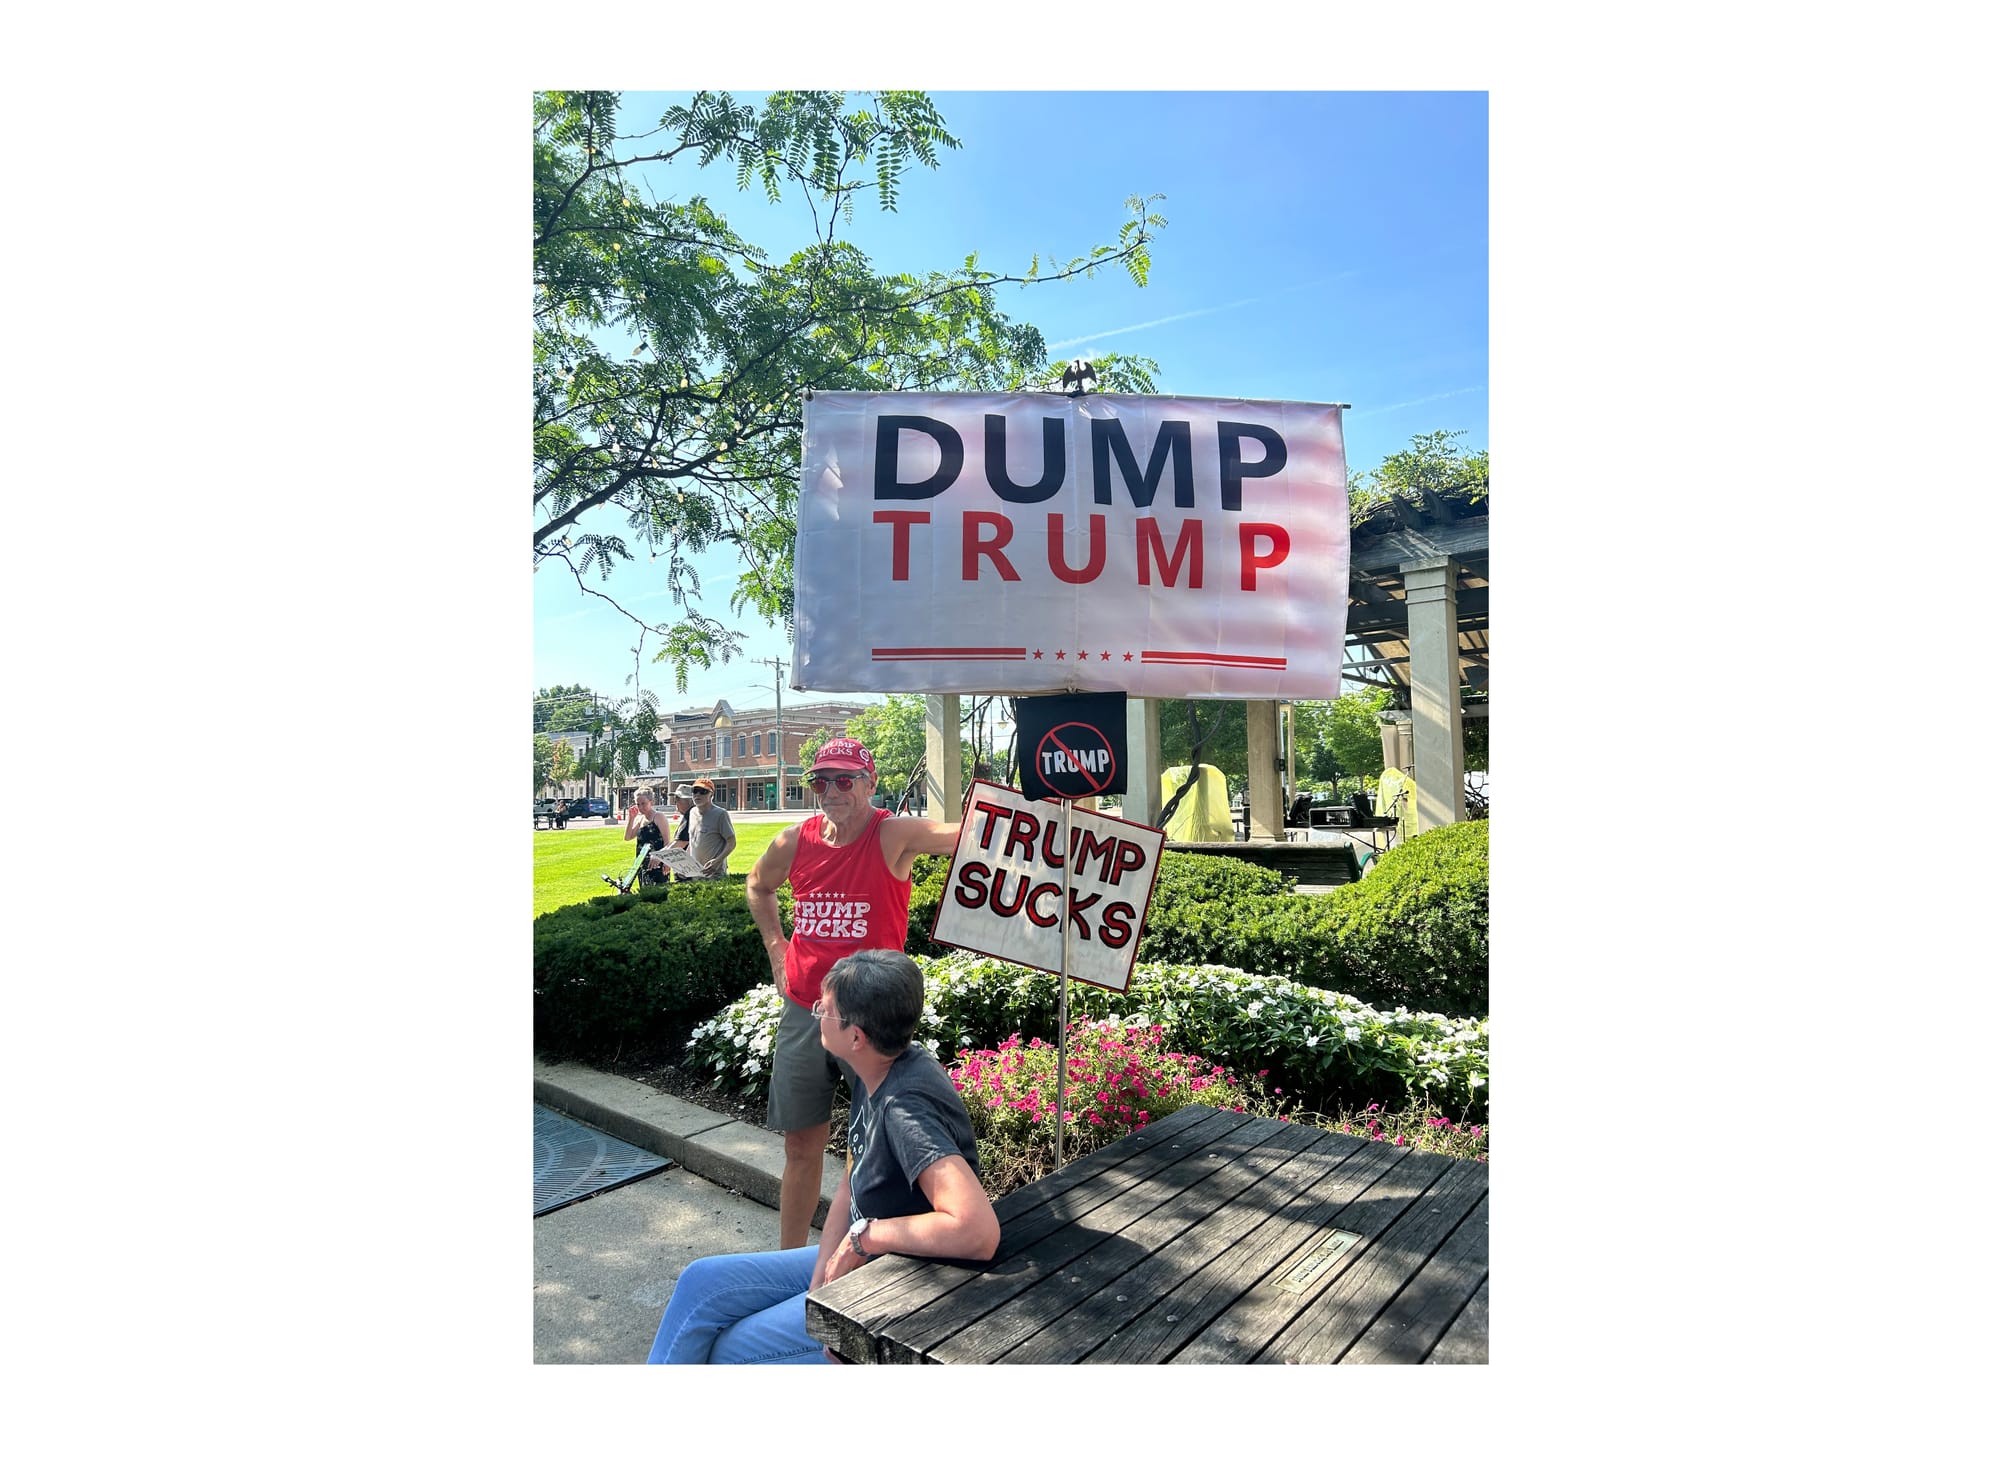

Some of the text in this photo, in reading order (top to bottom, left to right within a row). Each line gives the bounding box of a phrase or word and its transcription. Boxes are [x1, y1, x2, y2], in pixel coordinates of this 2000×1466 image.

[873, 414, 1288, 511] DUMP
[872, 510, 1291, 592] TRUMP
[1041, 749, 1110, 775] TRUMP
[975, 801, 1146, 886] TRUMP
[954, 862, 1137, 949] SUCKS
